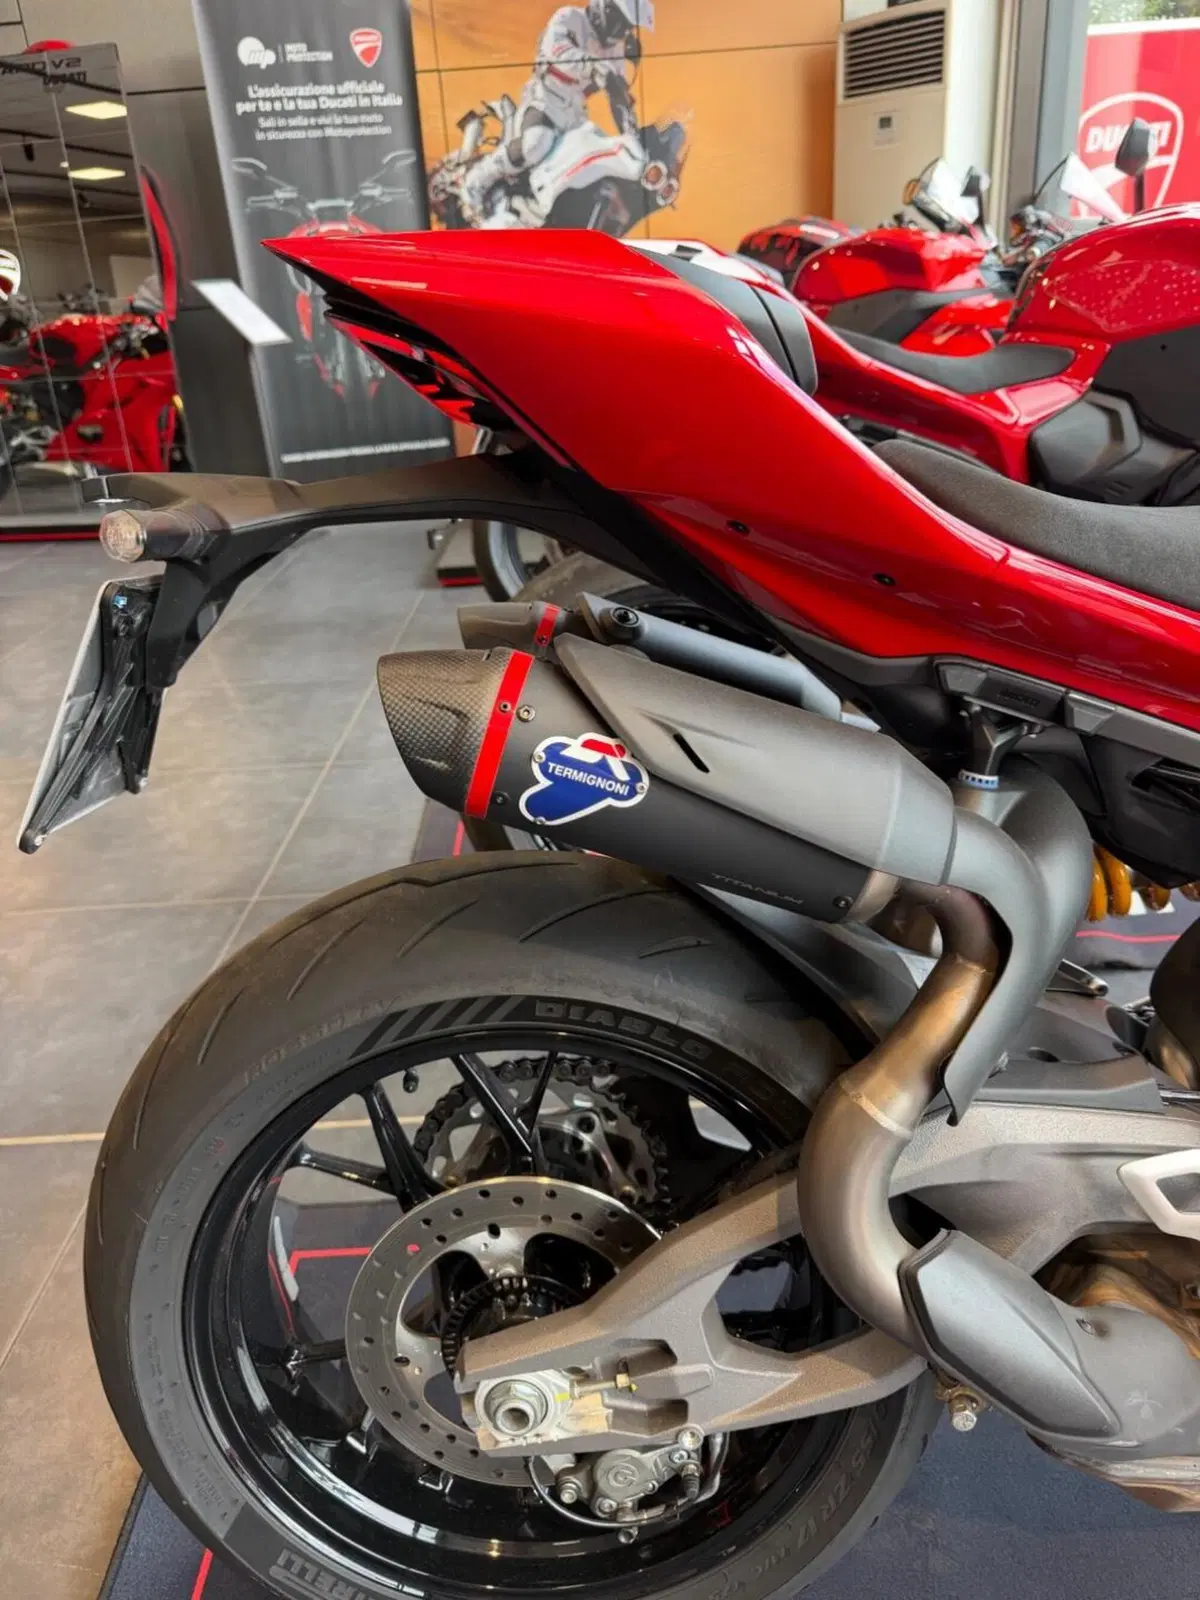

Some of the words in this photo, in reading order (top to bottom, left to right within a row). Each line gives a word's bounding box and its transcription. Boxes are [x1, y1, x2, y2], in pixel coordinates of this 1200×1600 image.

[248, 82, 336, 99] L'assicurazione
[337, 80, 385, 95] ufficiale
[236, 102, 256, 116] per
[259, 100, 272, 111] te
[274, 102, 282, 111] e
[283, 99, 296, 111] la
[319, 96, 357, 109] Ducati
[359, 95, 371, 107] in
[372, 93, 403, 107] Italia
[547, 762, 629, 796] TERMIGNONI
[534, 999, 713, 1061] DIABLO
